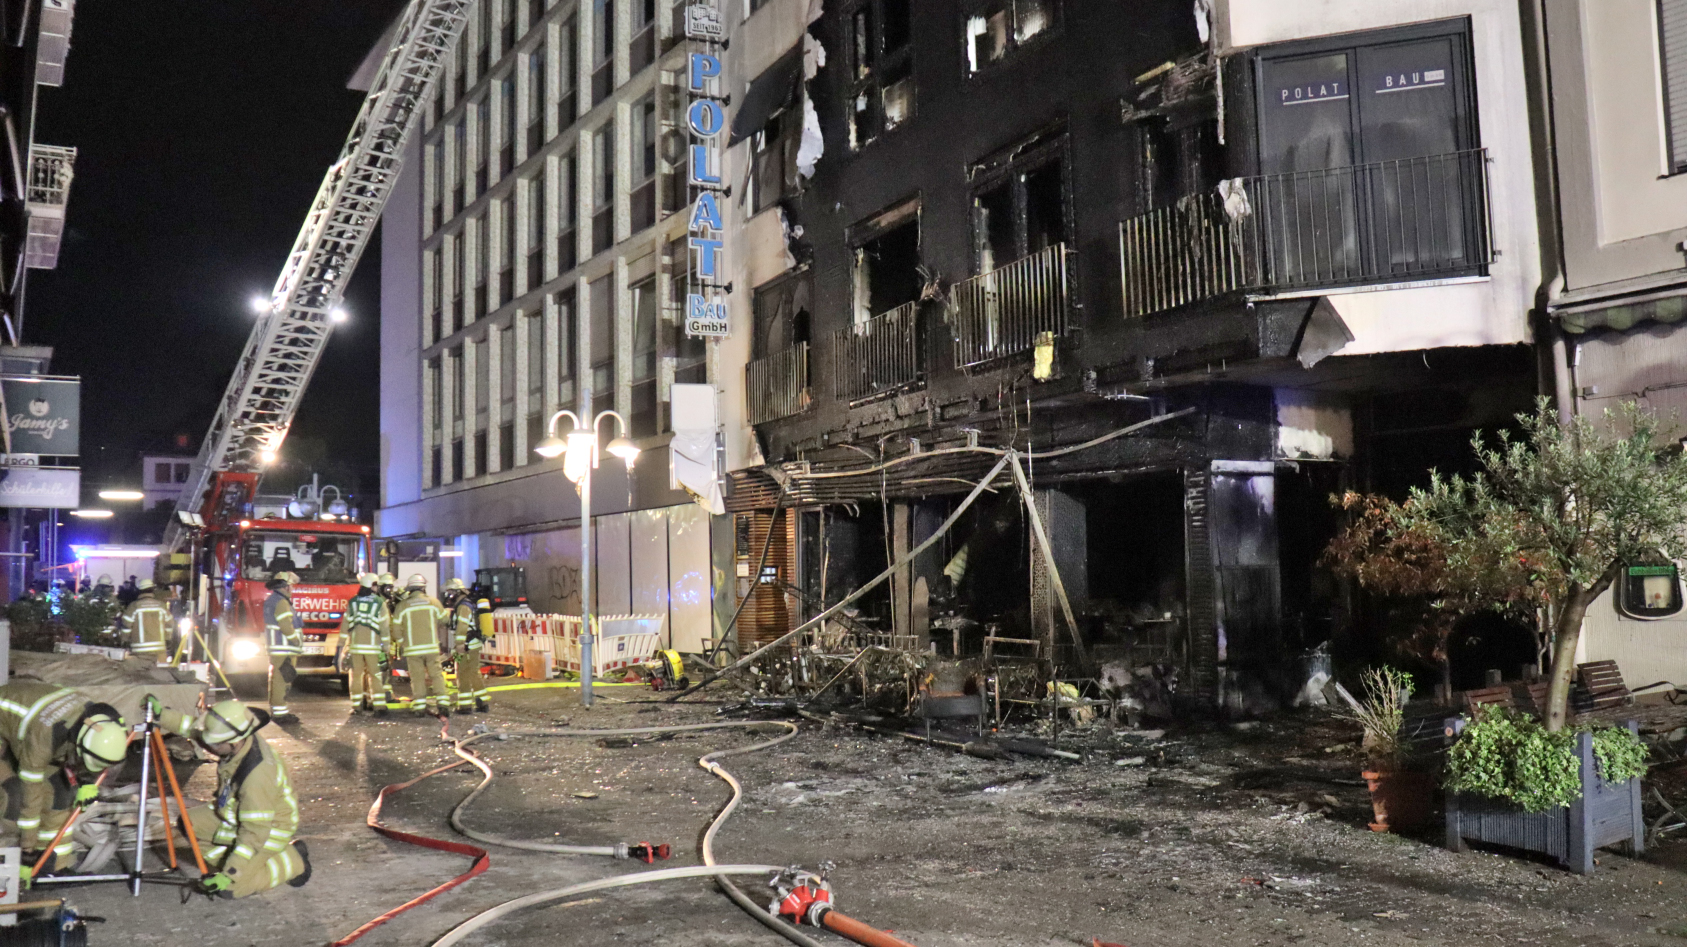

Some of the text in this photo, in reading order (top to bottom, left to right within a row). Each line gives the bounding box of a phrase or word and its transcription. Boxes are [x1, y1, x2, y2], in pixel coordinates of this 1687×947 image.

[693, 22, 706, 30] SEIT
[1281, 72, 1420, 100] POLAT BAU
[686, 52, 724, 279] POLAT
[689, 320, 728, 333] GmbH
[8, 413, 70, 440] Jamy's
[290, 597, 349, 610] ERWEHR
